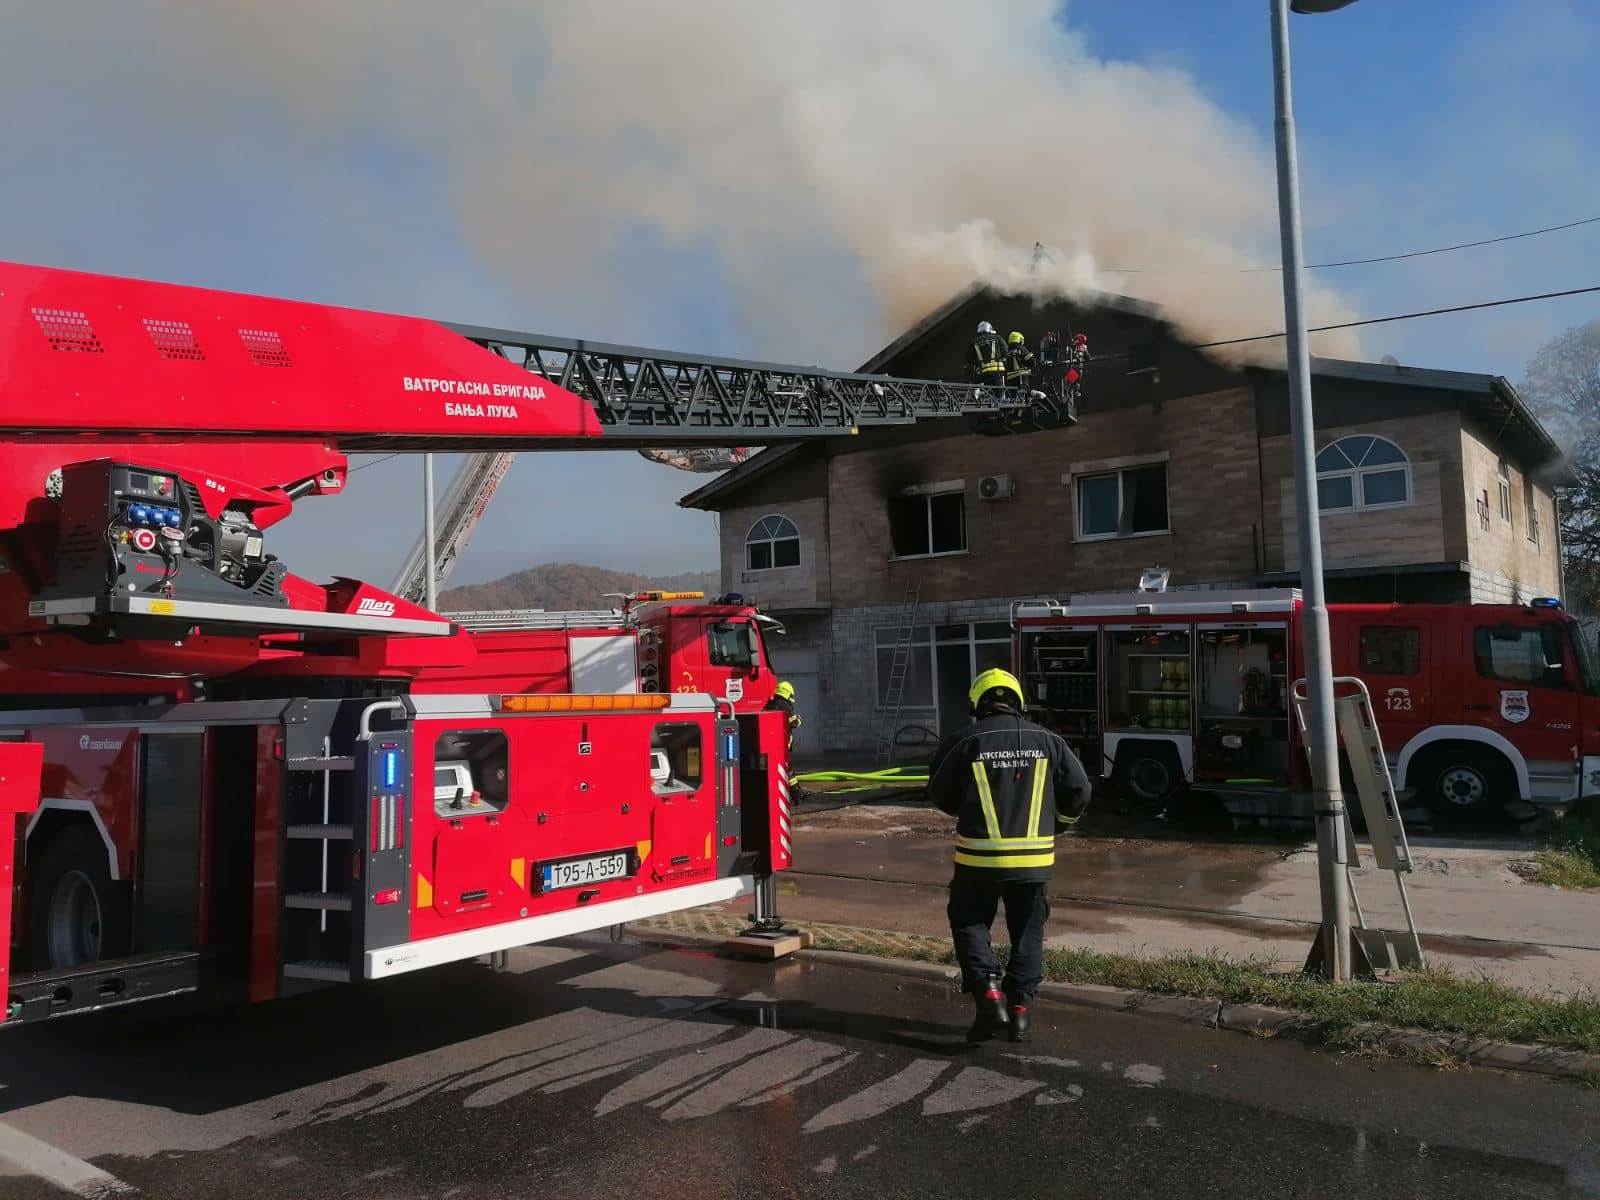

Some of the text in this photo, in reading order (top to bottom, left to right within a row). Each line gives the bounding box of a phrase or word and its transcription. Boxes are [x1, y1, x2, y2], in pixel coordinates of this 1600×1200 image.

[403, 376, 546, 400] ВАТРОГАСНА БРИГАДА
[445, 402, 518, 418] БАЊА ЛУКА
[358, 597, 395, 613] Metz
[1384, 697, 1412, 711] 123
[554, 857, 624, 886] T95-A-559
